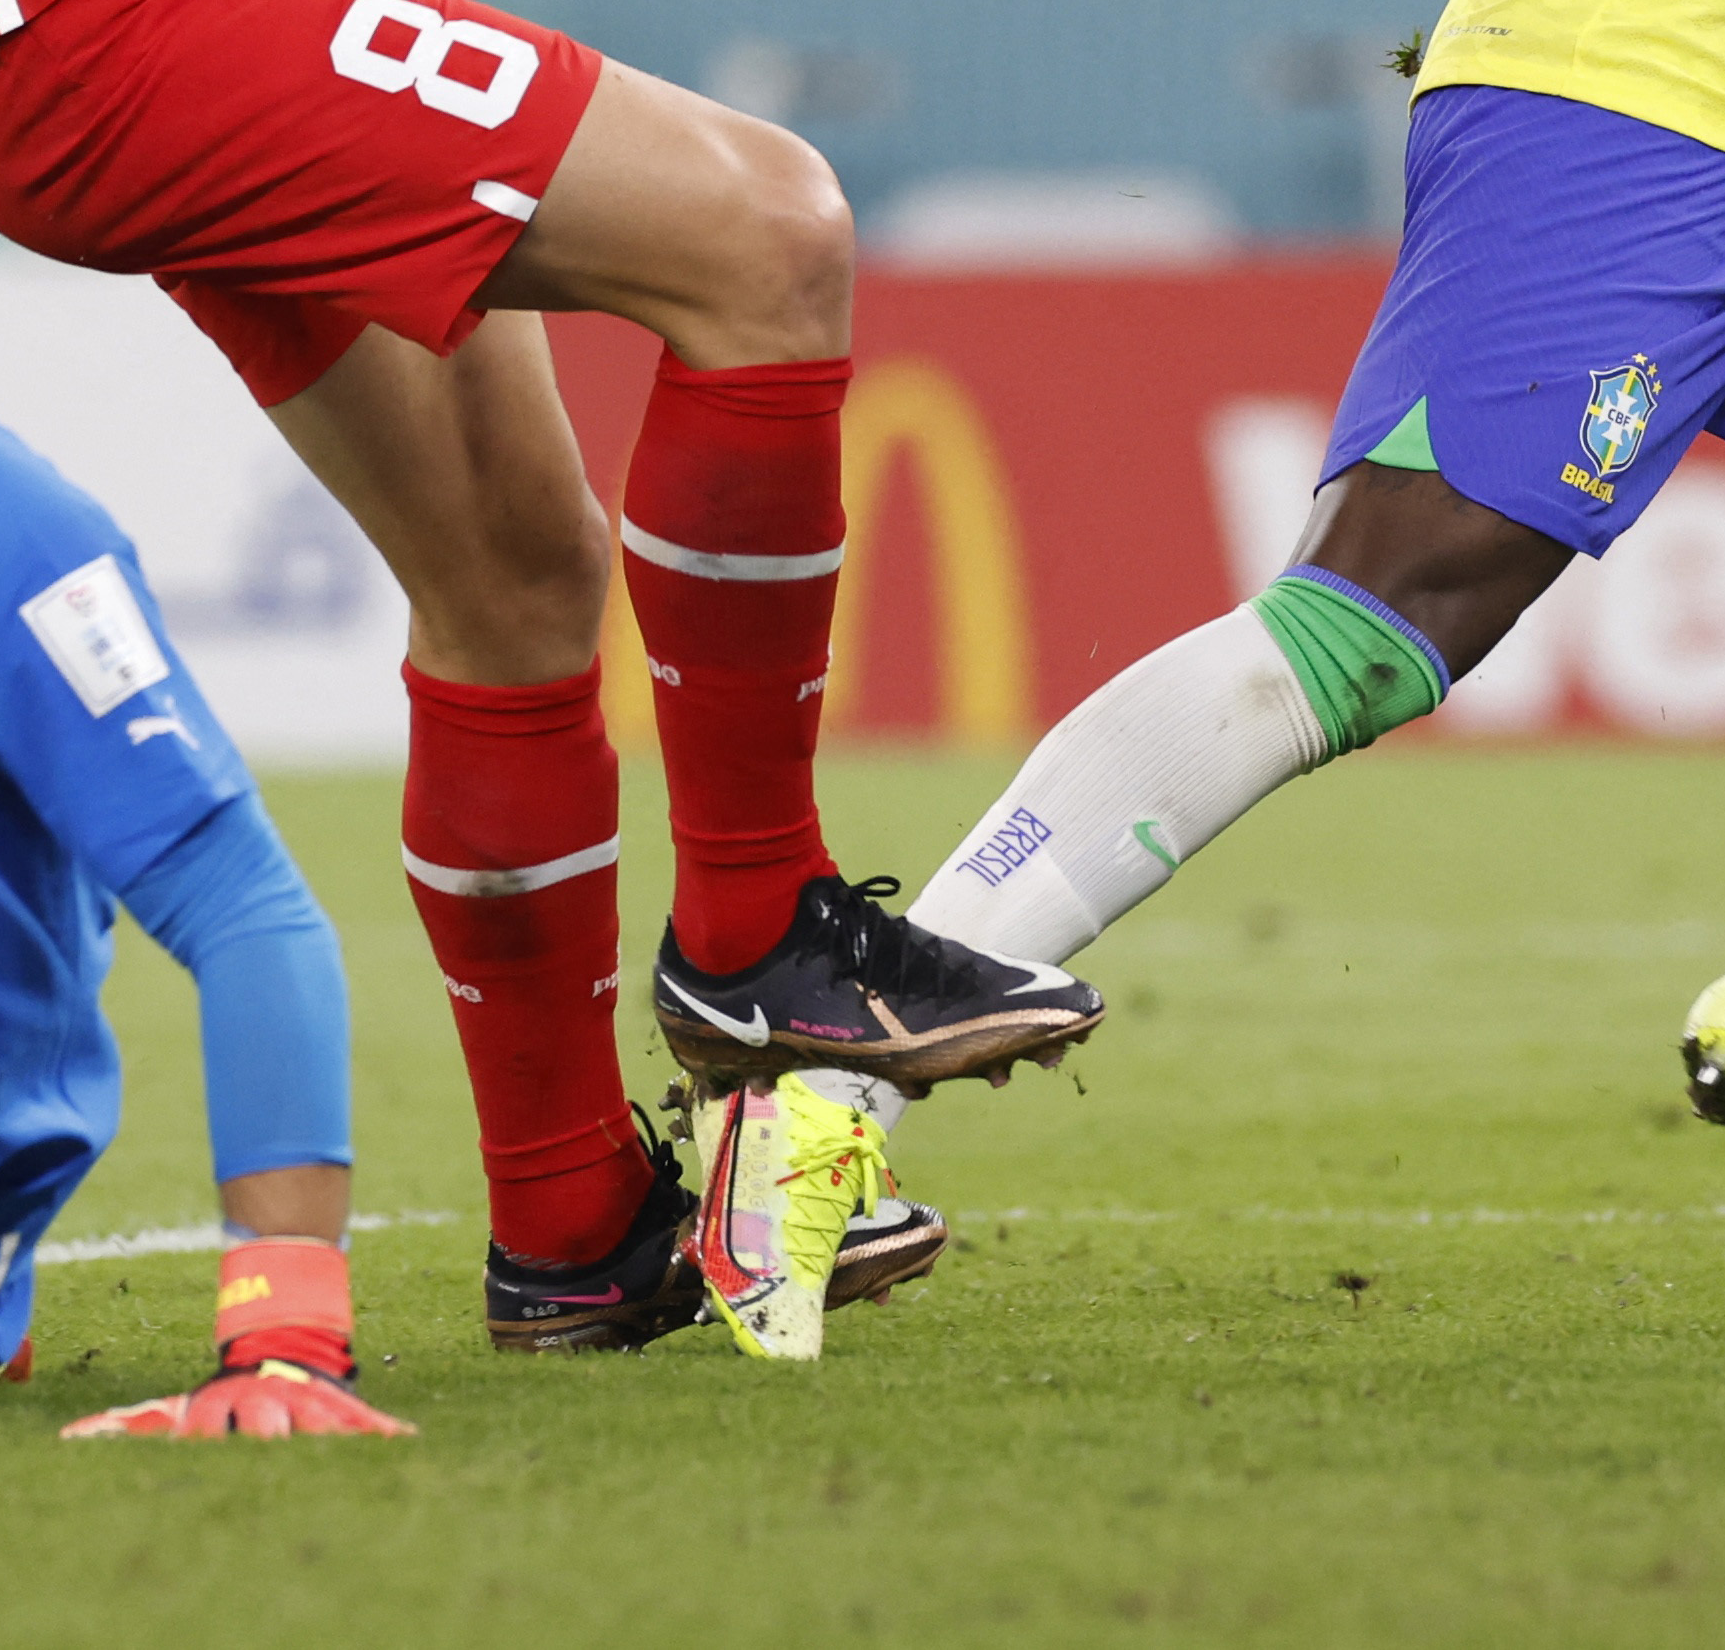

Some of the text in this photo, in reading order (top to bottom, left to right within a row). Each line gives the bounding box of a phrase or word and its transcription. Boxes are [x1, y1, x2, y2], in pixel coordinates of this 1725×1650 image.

[1607, 408, 1631, 426] CBF
[1560, 462, 1615, 504] BRASIL
[955, 807, 1053, 887] BRASIL
